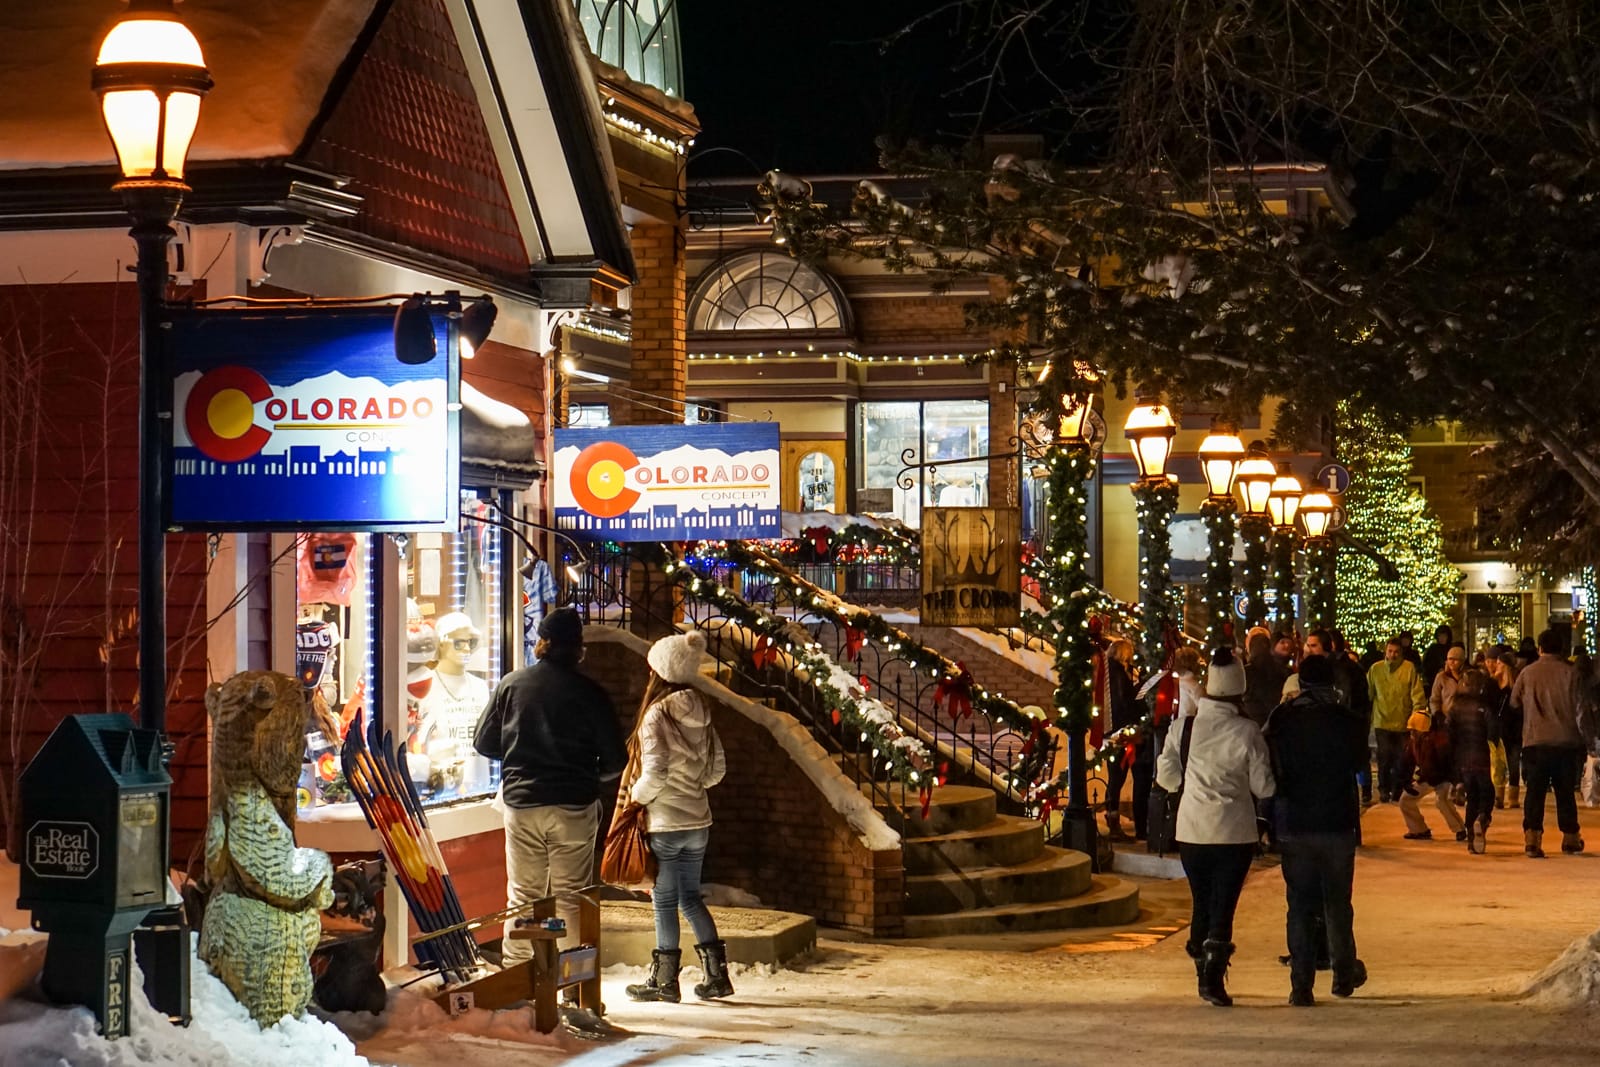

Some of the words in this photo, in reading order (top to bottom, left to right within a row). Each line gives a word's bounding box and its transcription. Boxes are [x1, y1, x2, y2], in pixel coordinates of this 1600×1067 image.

[185, 364, 433, 462] COLORADO
[569, 441, 770, 519] COLORADO
[808, 482, 828, 496] OPEN
[701, 490, 768, 501] CONCEPT
[924, 589, 955, 609] THE
[34, 836, 48, 846] The
[48, 829, 88, 849] Real
[35, 844, 90, 866] Estate
